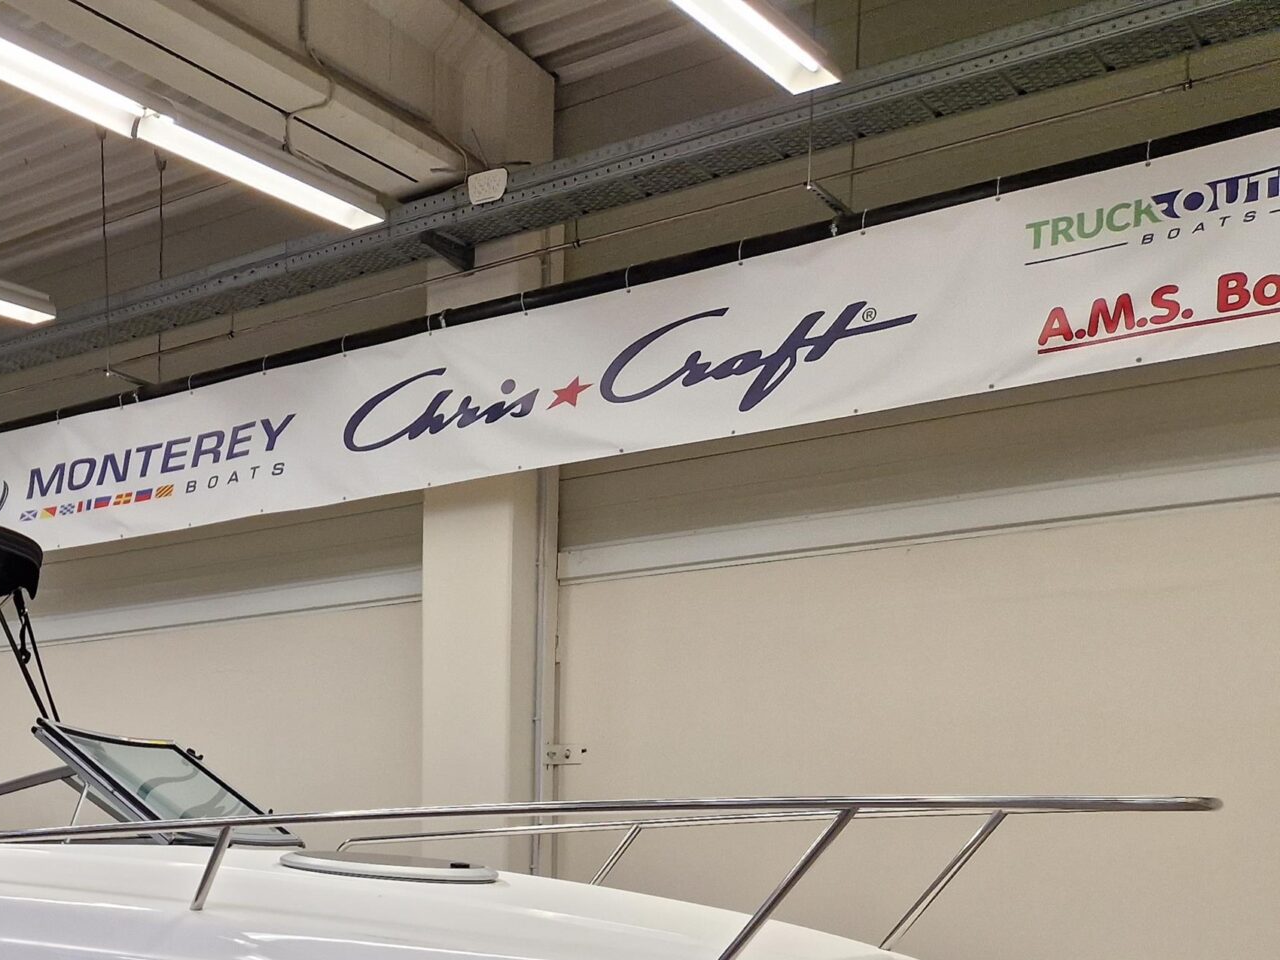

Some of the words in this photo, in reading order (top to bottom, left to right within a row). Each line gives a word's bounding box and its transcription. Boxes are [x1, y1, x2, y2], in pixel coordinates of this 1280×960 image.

[1141, 211, 1257, 244] BOATS
[1038, 284, 1194, 346] A.M.S.
[343, 367, 540, 452] Chris
[600, 301, 917, 412] Craft
[25, 413, 296, 500] MONTEREY
[185, 462, 285, 494] BOATS
